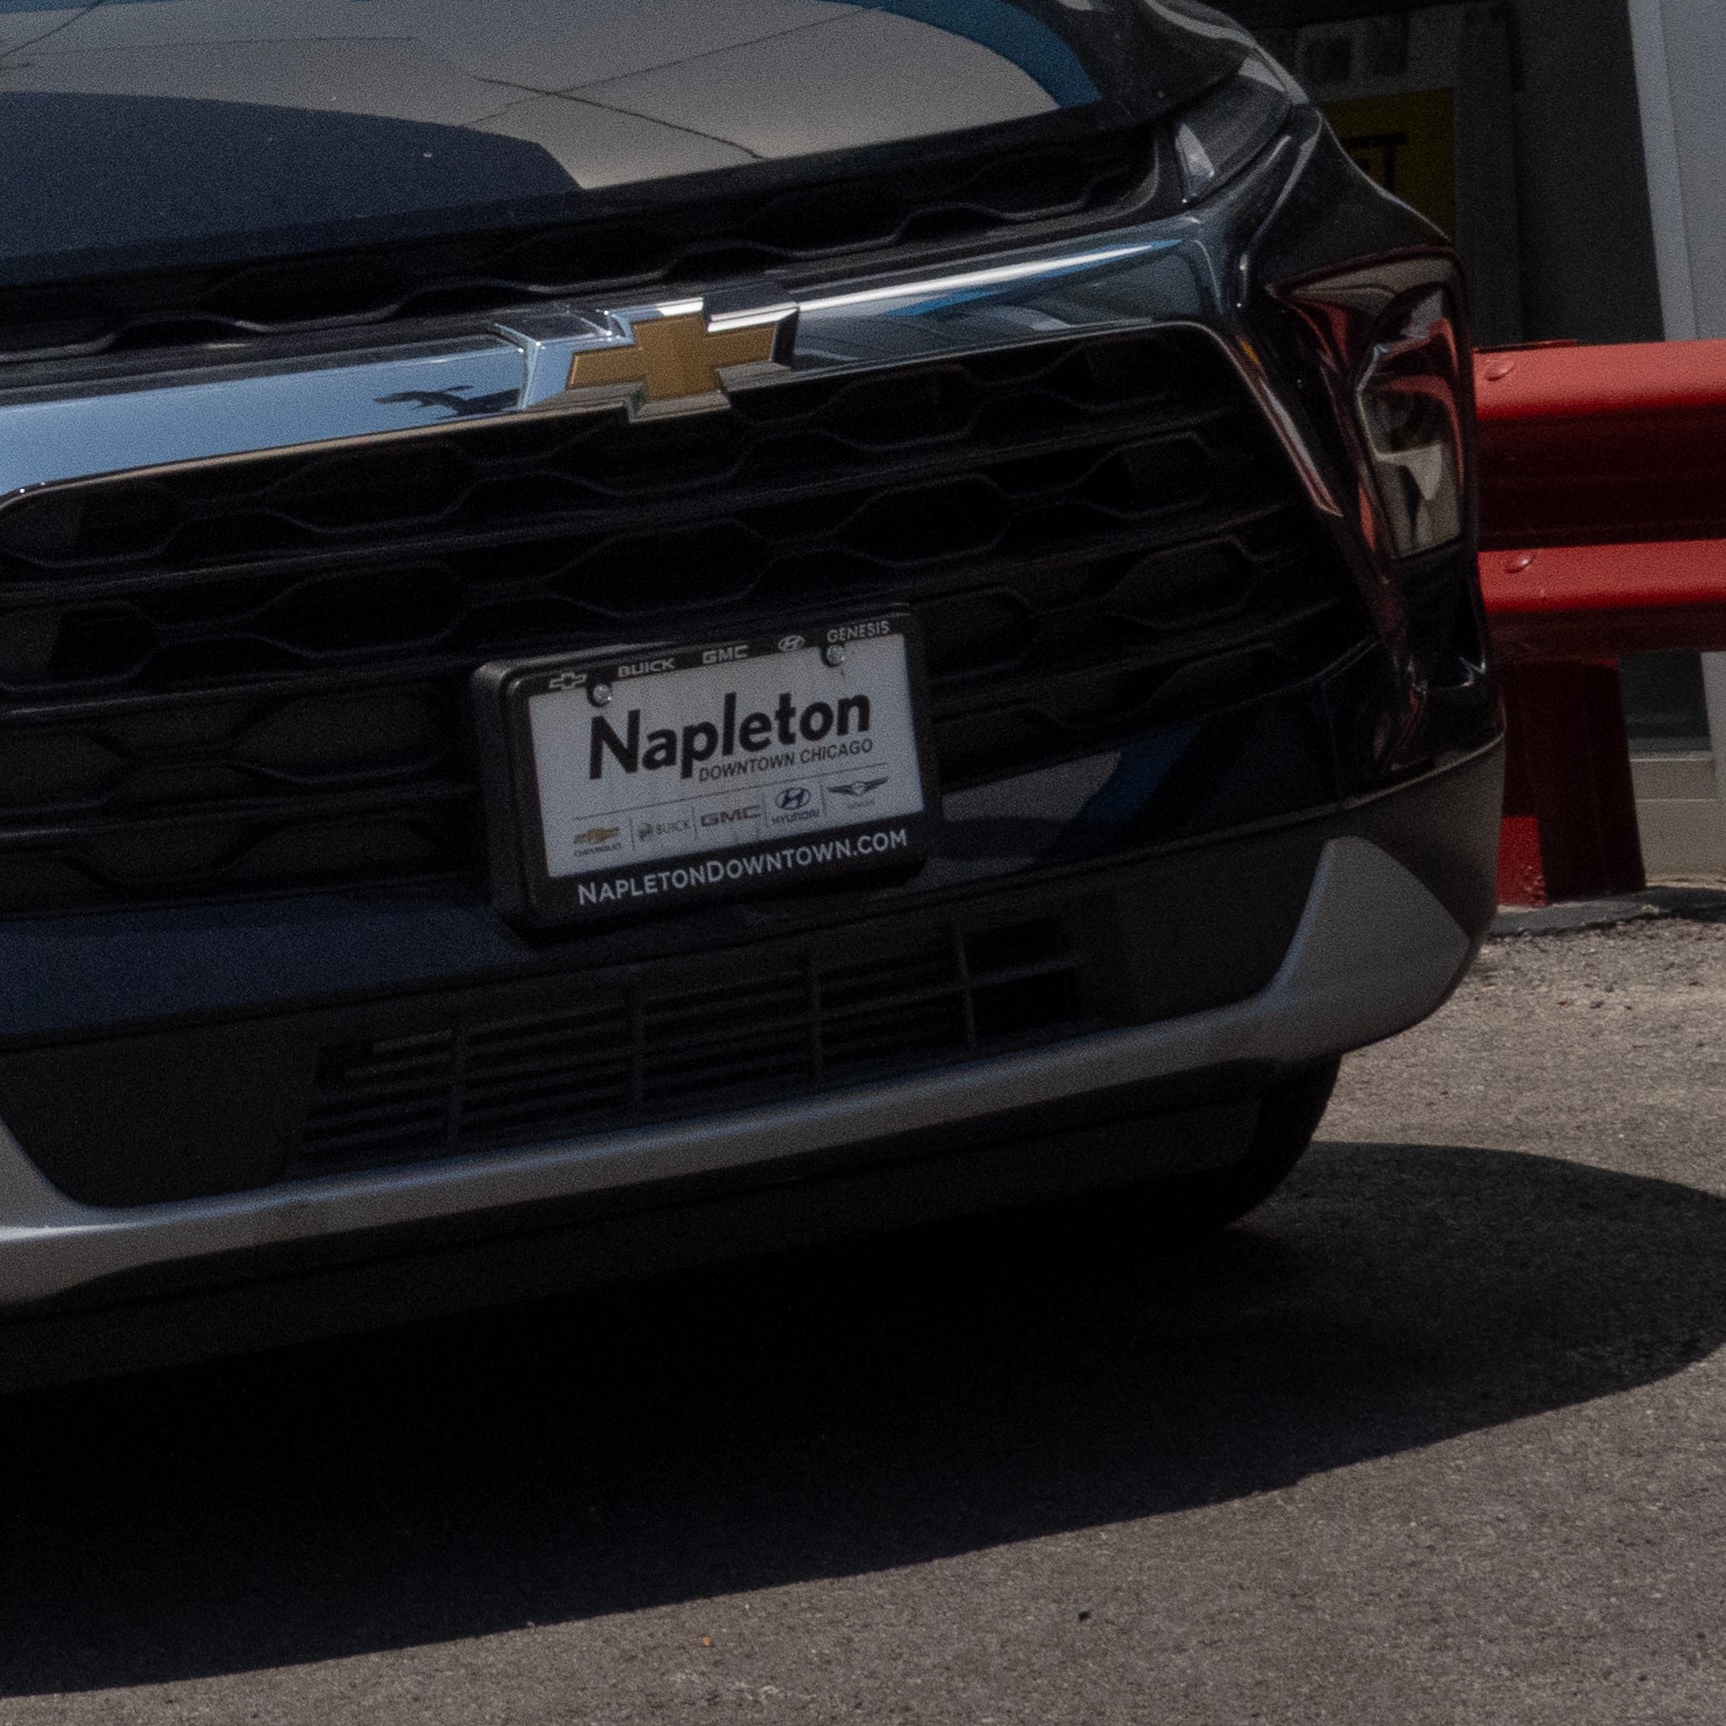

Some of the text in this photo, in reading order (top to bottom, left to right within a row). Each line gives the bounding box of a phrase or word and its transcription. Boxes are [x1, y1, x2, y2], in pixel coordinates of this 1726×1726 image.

[617, 620, 891, 679] BUICK GMC GENESIS
[589, 692, 871, 780] Napleton
[698, 738, 873, 782] DOWNTOWN CHICAGO
[701, 804, 762, 827] GMC
